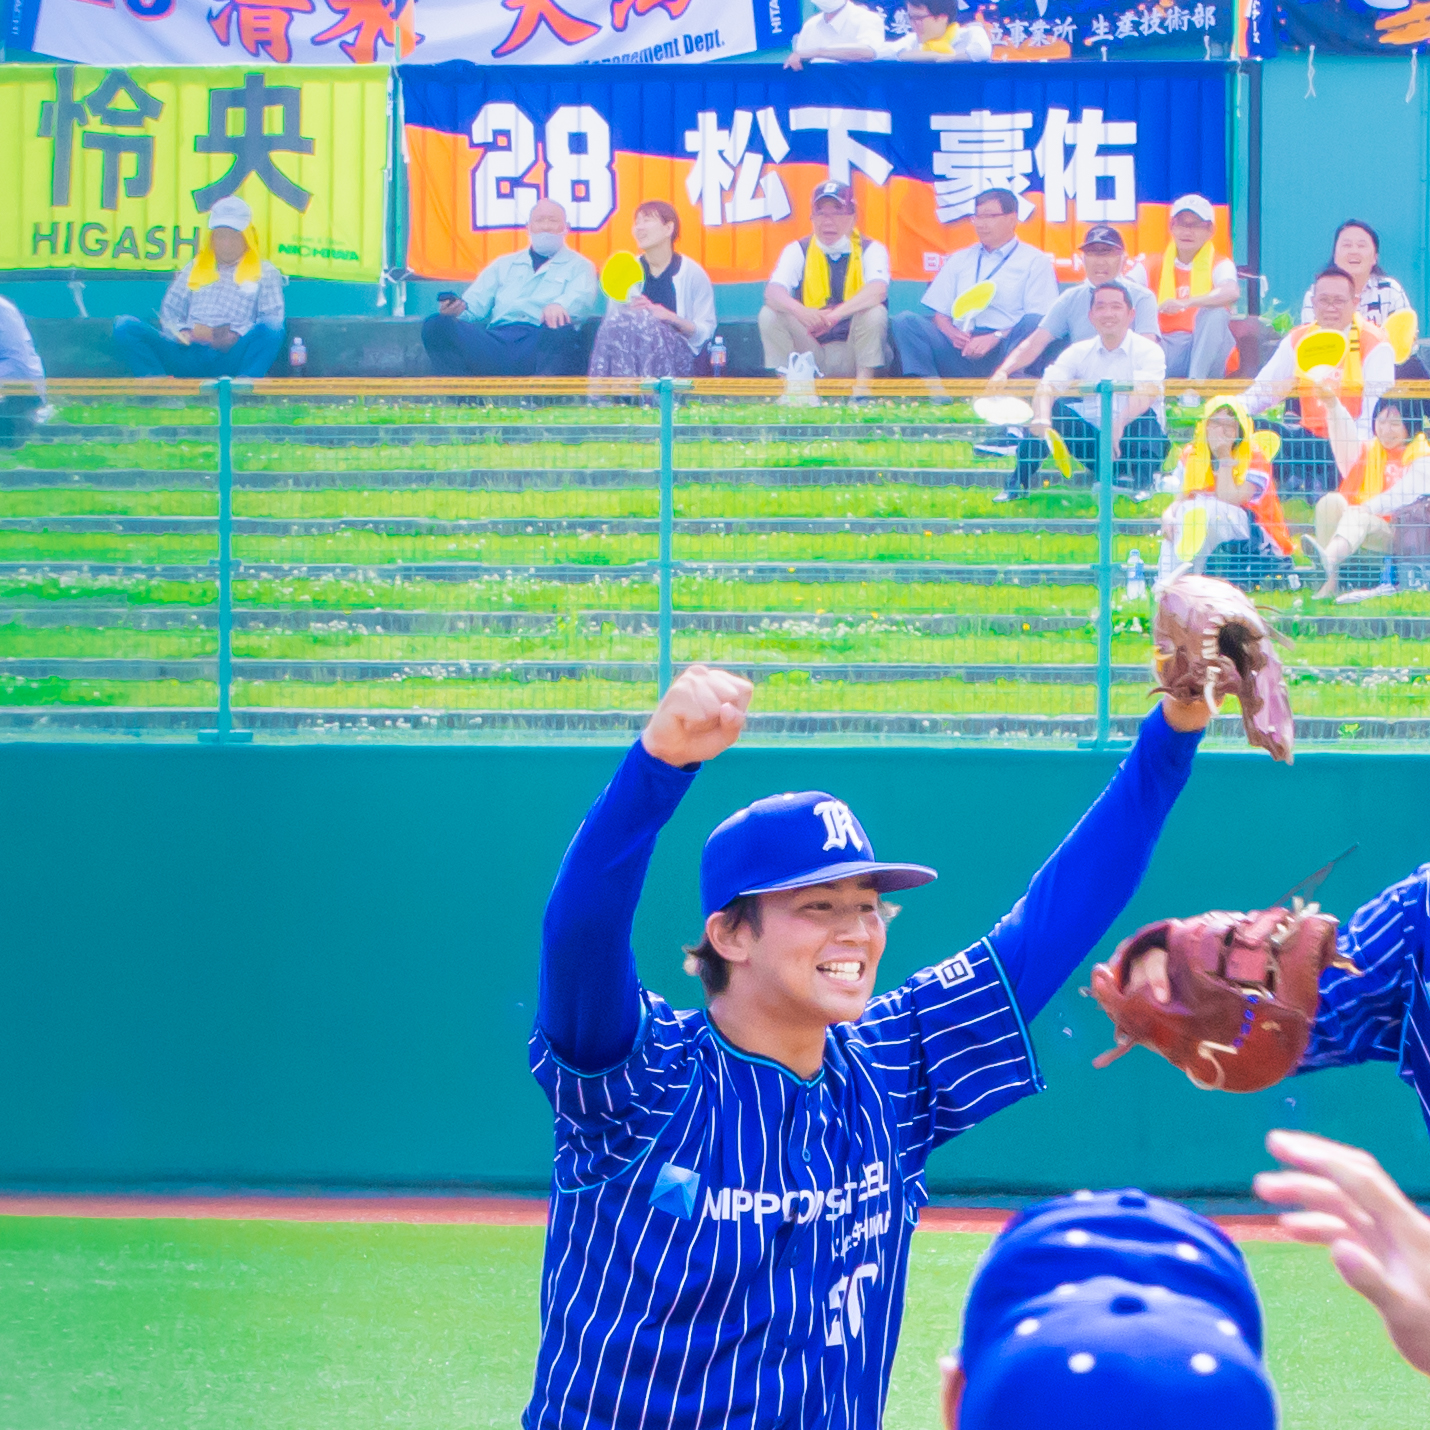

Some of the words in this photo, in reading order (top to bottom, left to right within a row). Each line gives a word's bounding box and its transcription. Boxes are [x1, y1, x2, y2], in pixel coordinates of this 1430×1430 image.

[683, 29, 725, 56] Dept.
[988, 16, 1077, 49] 立事業所
[1090, 3, 1217, 42] 生産技術部
[470, 102, 617, 232] 28
[685, 106, 895, 226] 松下
[929, 108, 1138, 224] 豪佑
